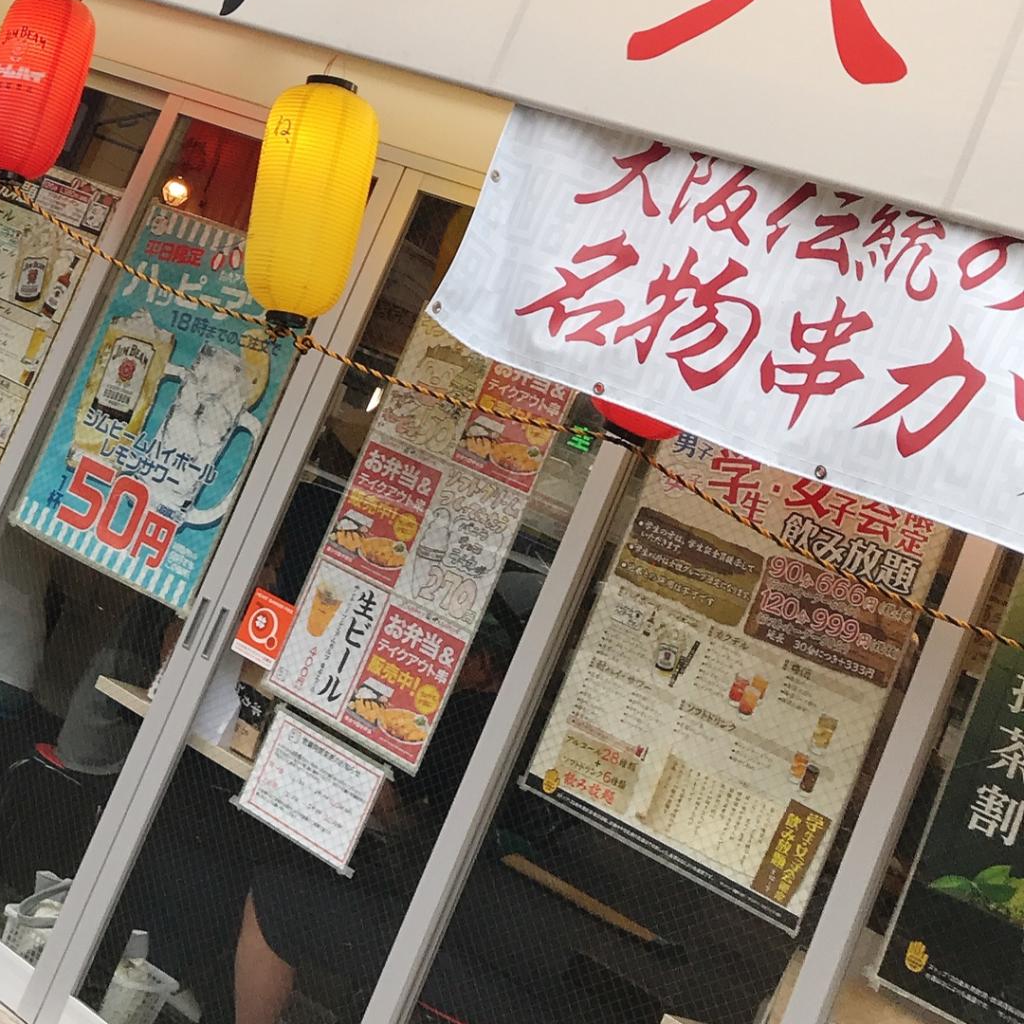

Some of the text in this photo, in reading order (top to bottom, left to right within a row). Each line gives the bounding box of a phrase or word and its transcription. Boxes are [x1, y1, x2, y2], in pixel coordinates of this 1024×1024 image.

[122, 260, 255, 320] ハッピーア
[515, 229, 1024, 458] 名物串カ
[83, 408, 217, 486] ジムビームハイボール
[101, 437, 181, 487] レモンサワー
[364, 449, 431, 496] お弁当&
[56, 455, 177, 570] 50円
[777, 512, 922, 597] 飲み放題
[317, 589, 377, 702] 生ビール
[383, 613, 456, 669] お弁当&
[367, 655, 421, 697] 販売中!
[684, 701, 738, 735] ソフトドリンク
